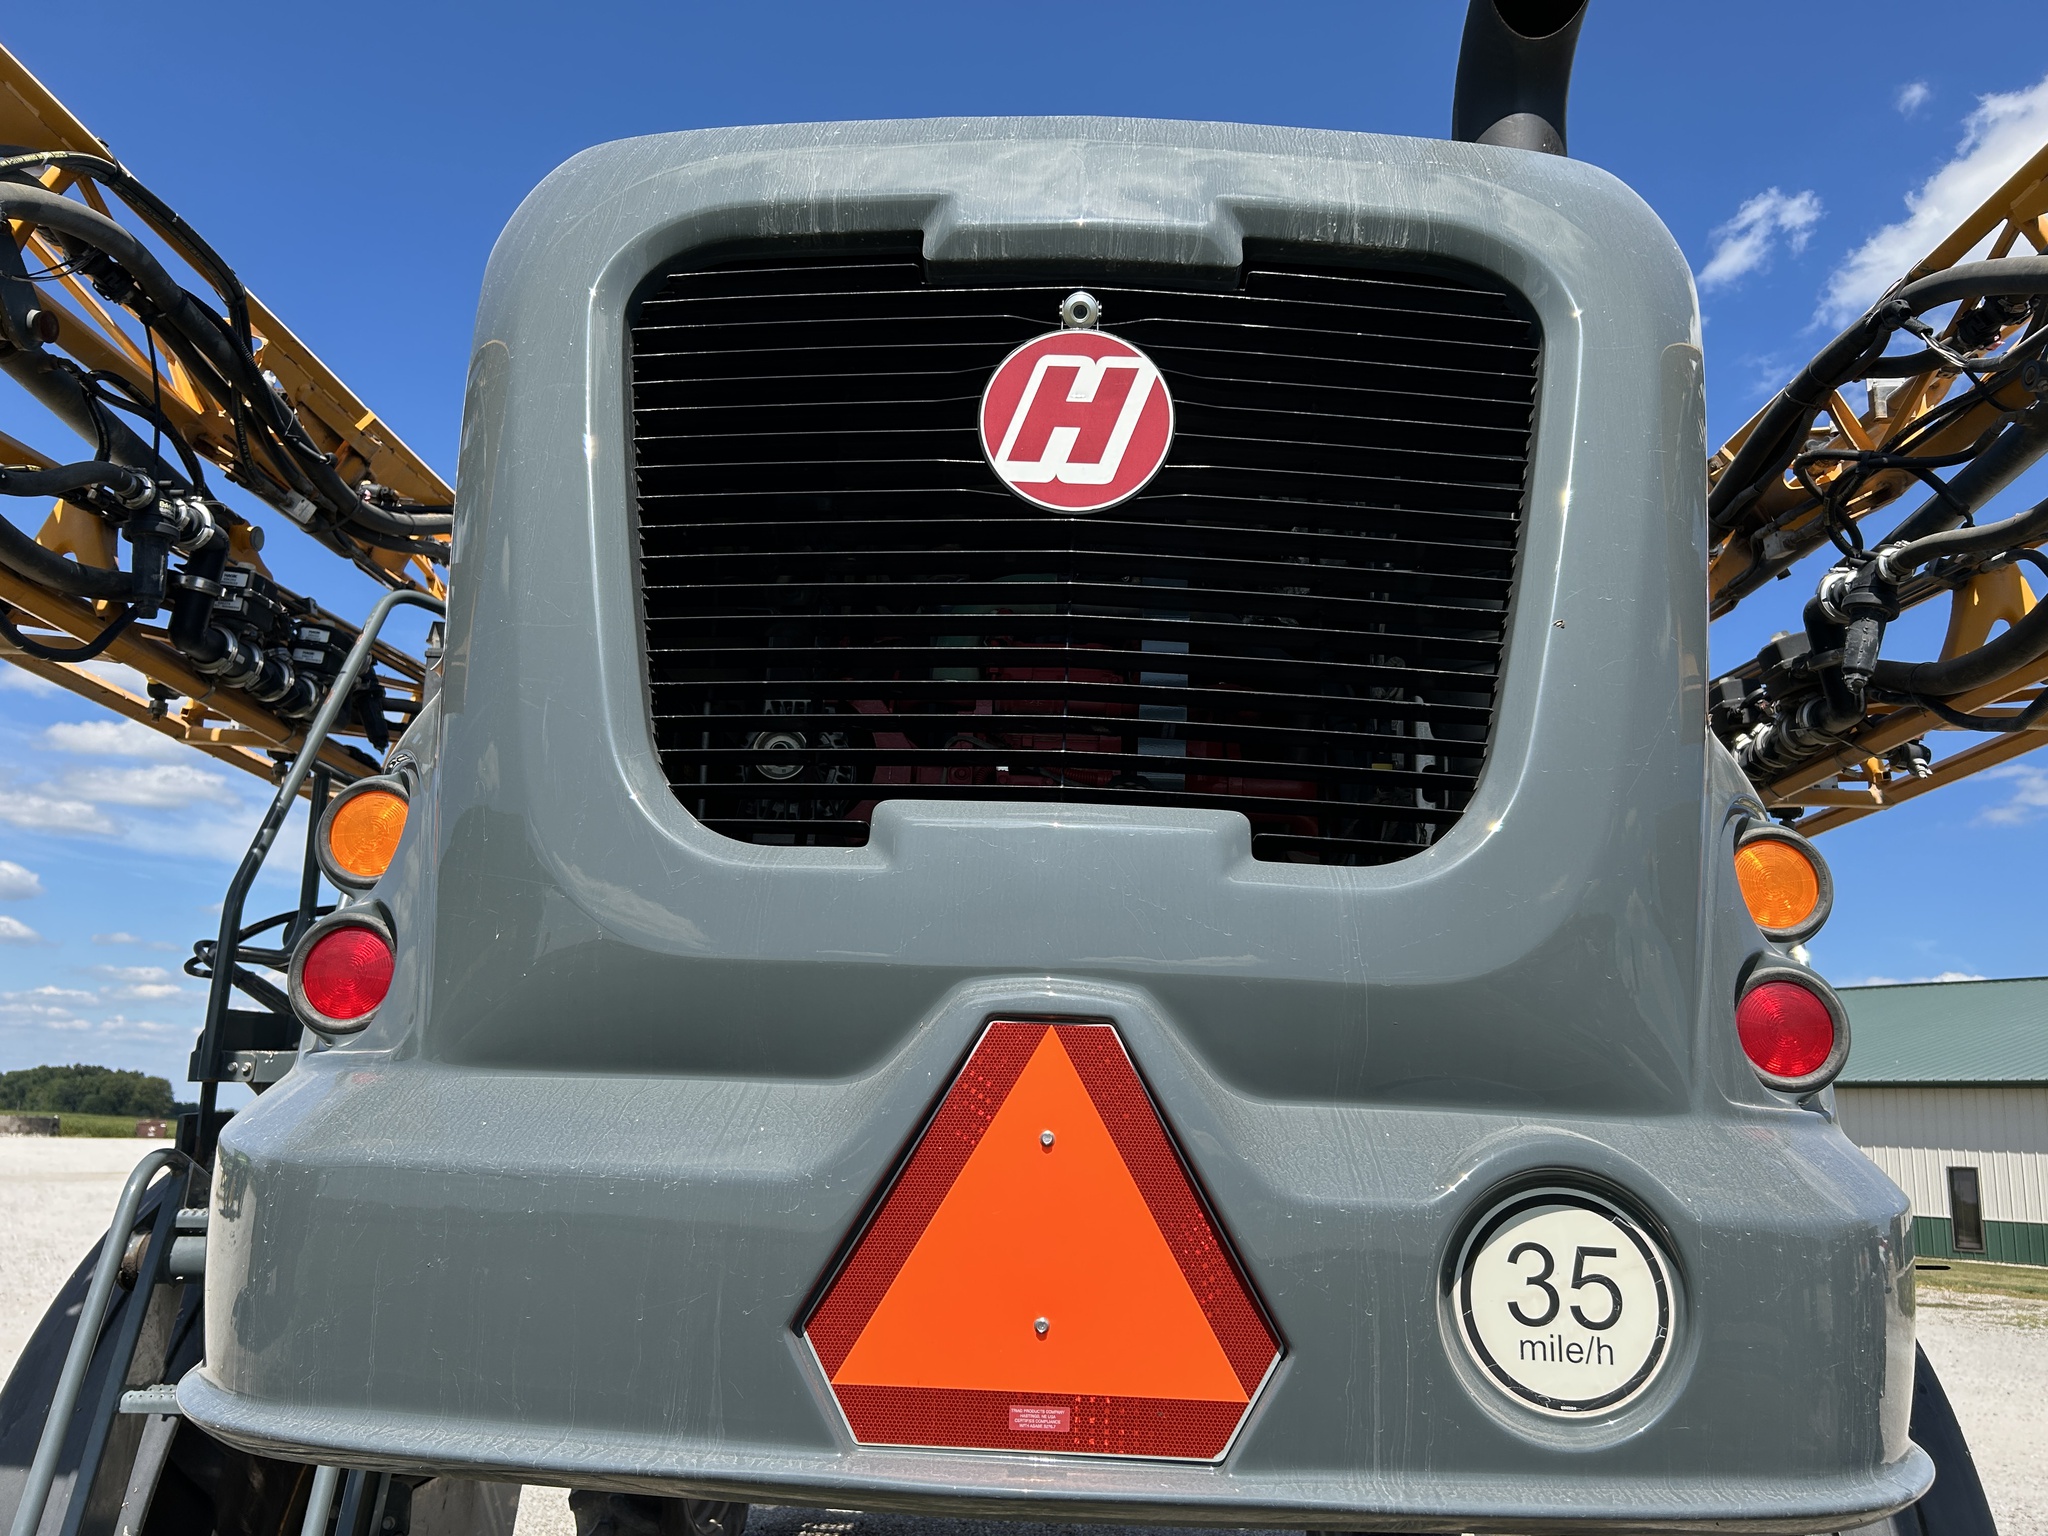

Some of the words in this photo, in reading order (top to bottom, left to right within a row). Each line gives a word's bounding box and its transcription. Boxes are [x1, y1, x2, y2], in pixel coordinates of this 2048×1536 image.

[1000, 359, 1150, 475] H
[1507, 1242, 1623, 1331] 35
[1519, 1334, 1614, 1365] mile/h
